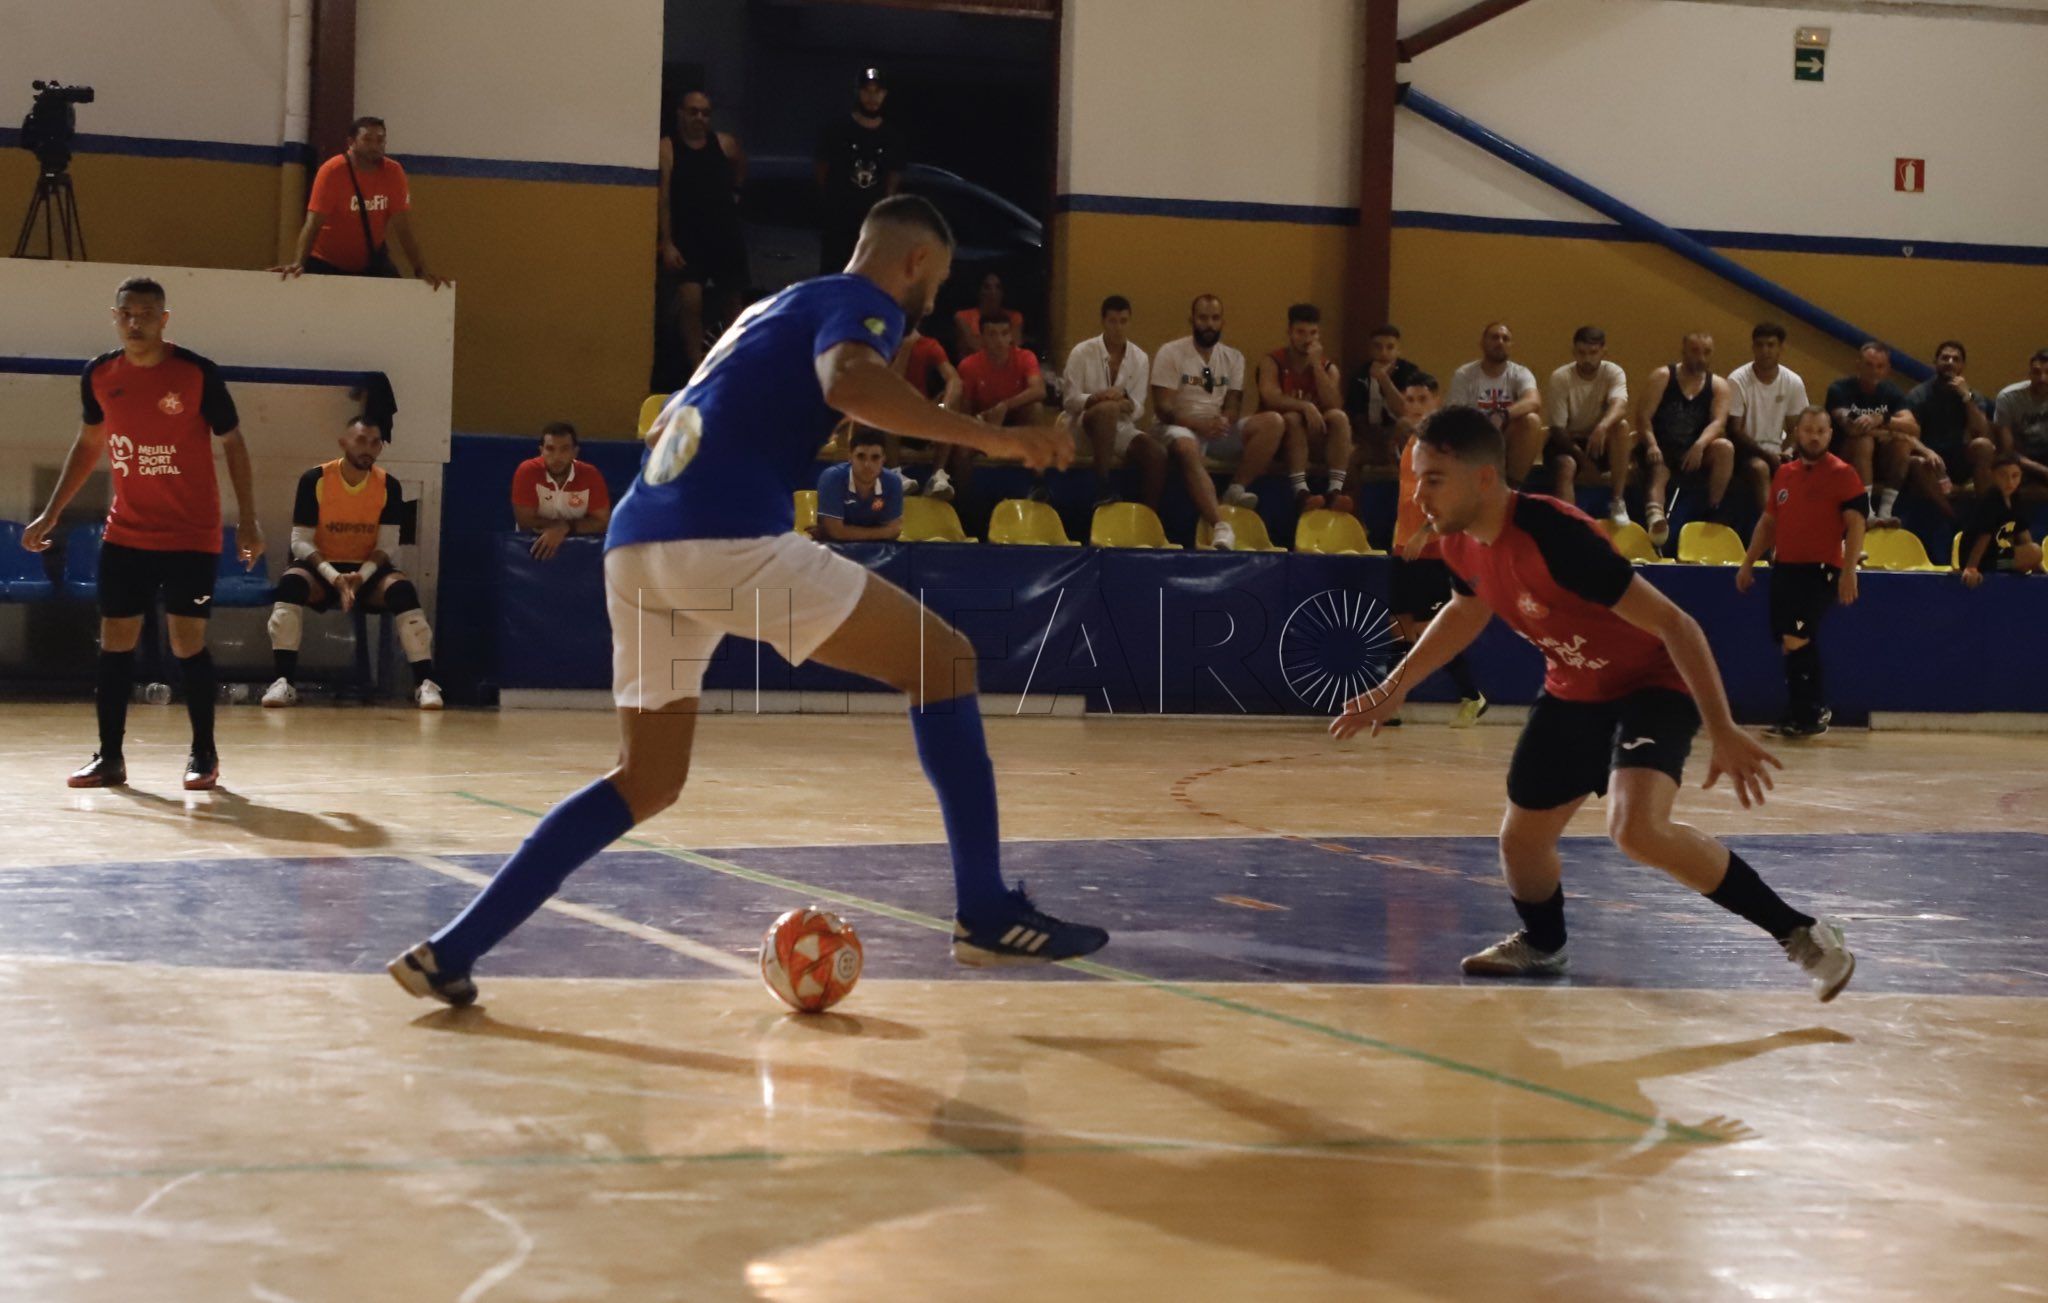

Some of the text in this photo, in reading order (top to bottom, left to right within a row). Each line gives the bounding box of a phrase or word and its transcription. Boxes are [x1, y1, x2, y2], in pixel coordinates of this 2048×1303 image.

[138, 445, 177, 455] MELILLA
[138, 455, 171, 466] SPORT
[139, 465, 181, 475] CAPITAL
